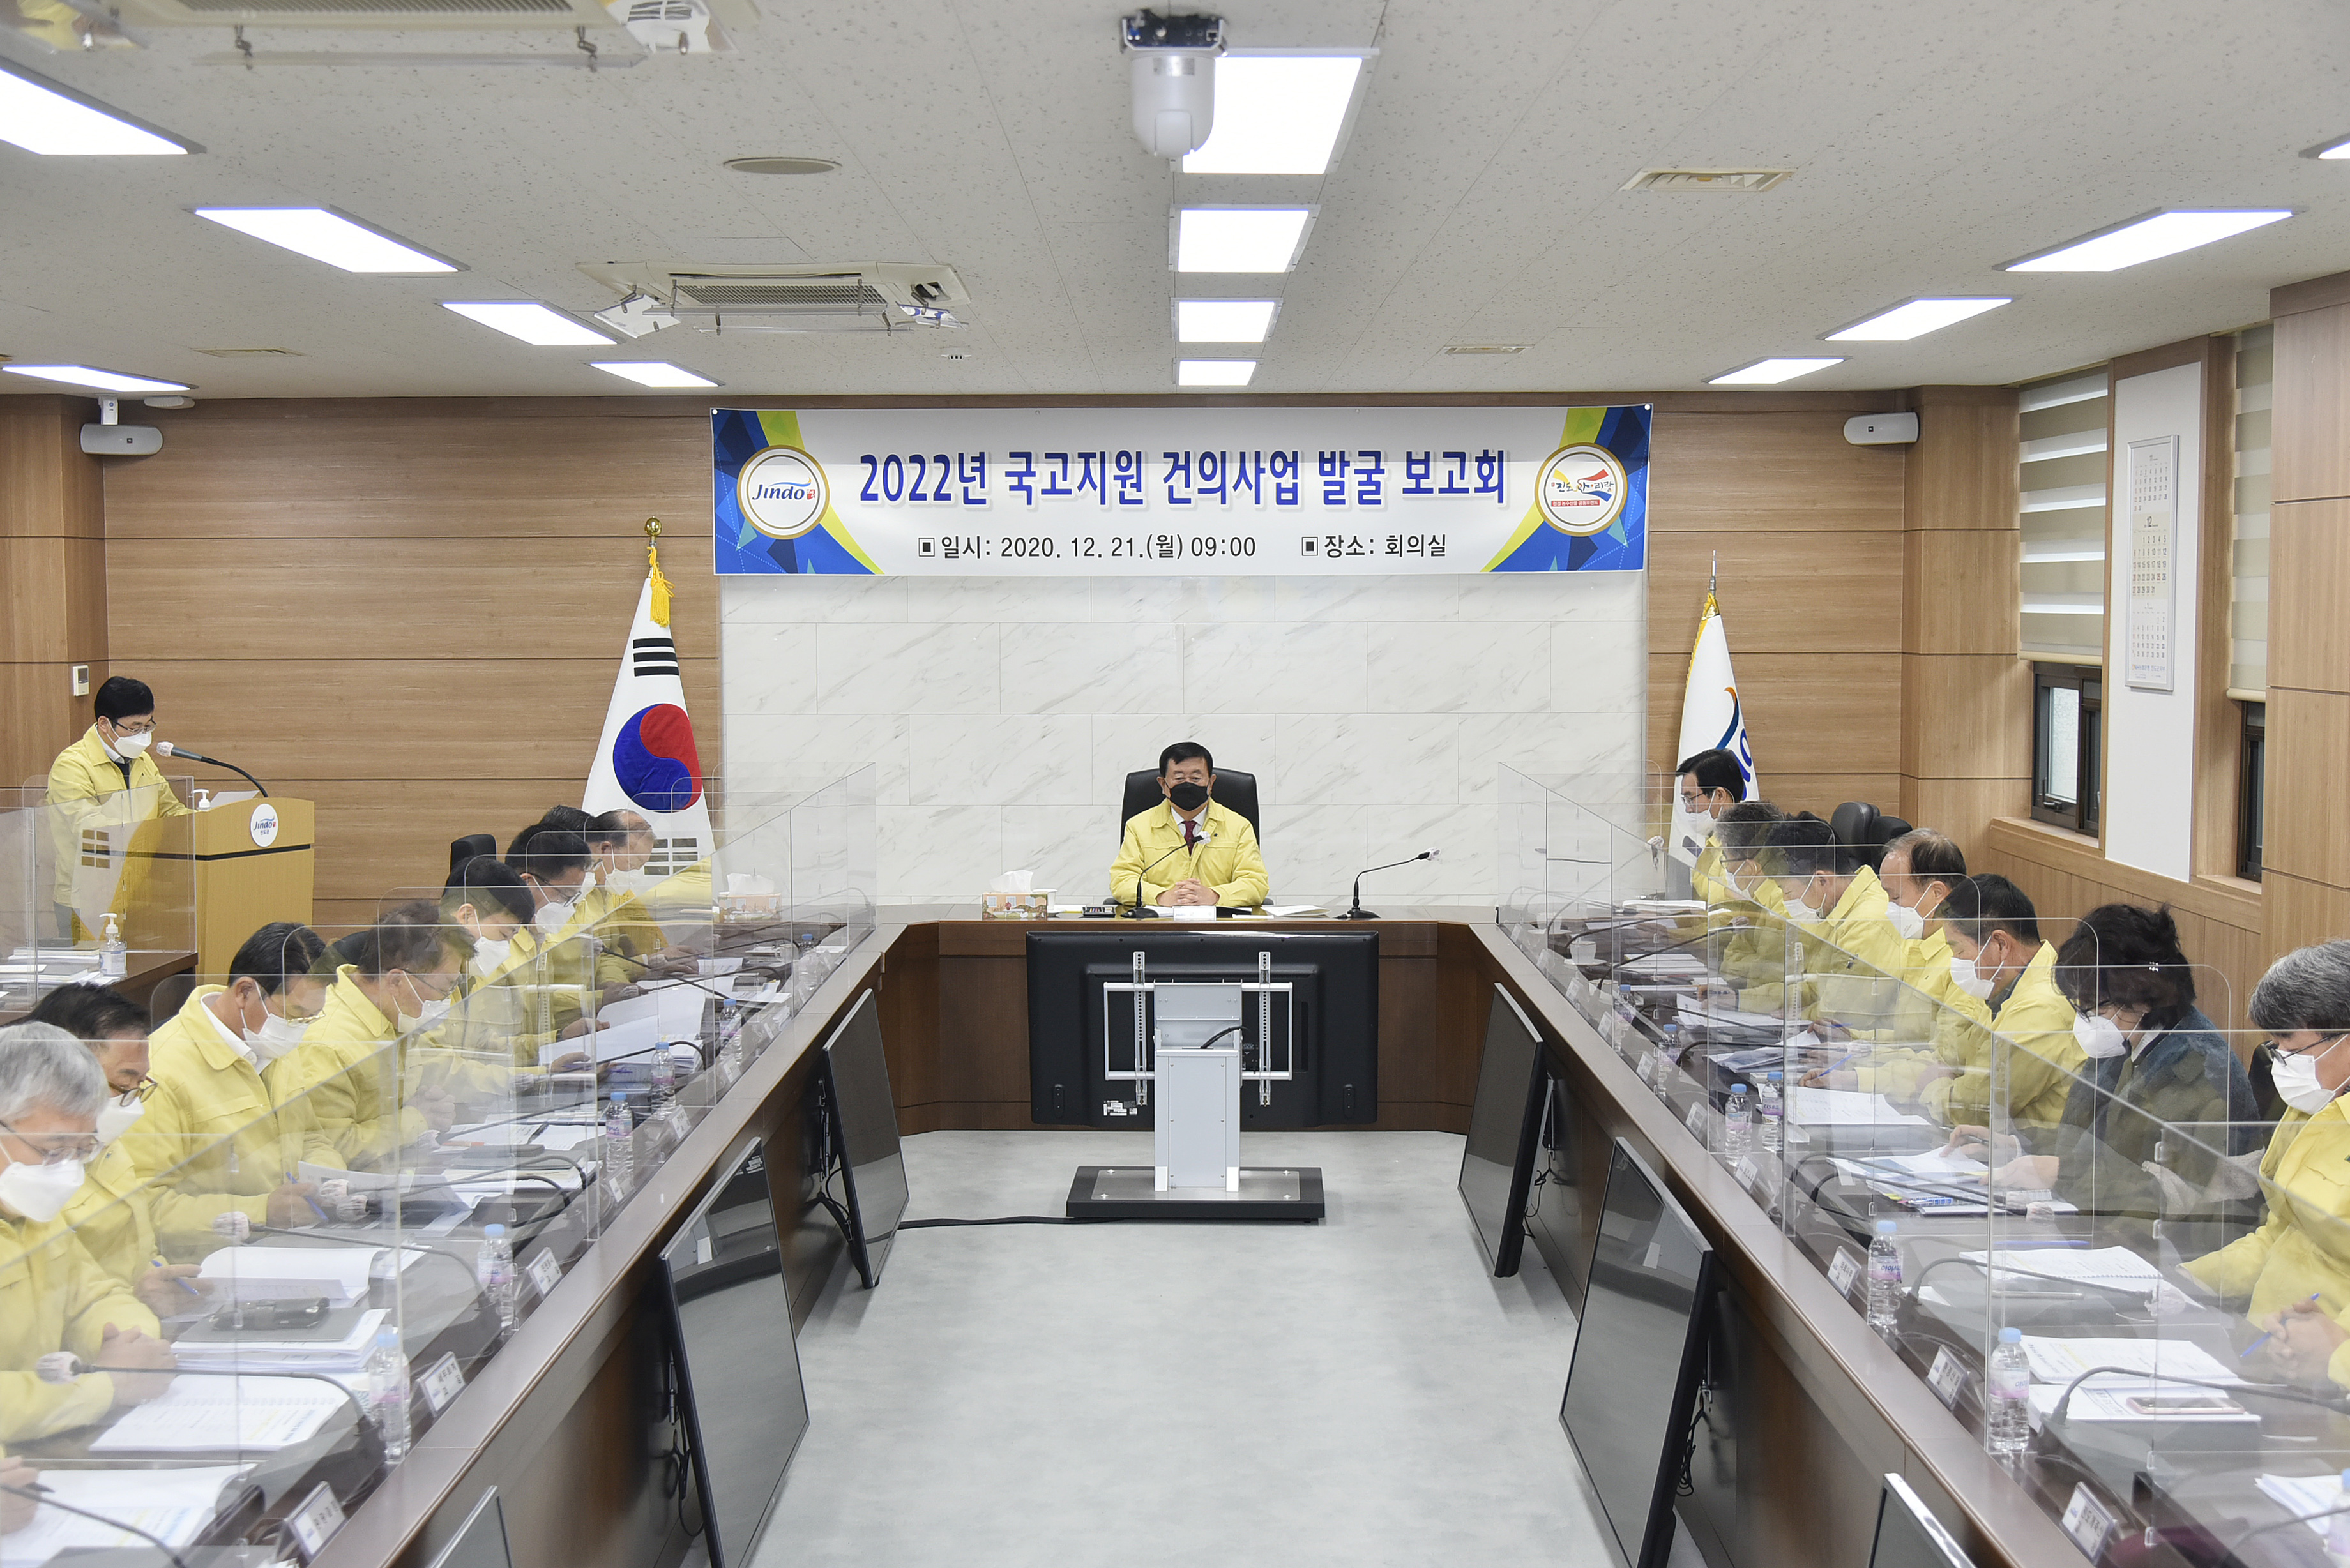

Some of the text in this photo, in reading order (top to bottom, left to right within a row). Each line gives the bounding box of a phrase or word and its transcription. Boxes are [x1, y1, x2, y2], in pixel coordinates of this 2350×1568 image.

[860, 449, 1505, 506] 2022년 국고지원 건의사업 발굴 보고회
[752, 484, 805, 500] Jindo
[941, 536, 991, 559] 일시:
[1001, 537, 1061, 558] 2020.
[1071, 537, 1103, 558] 12.
[1191, 536, 1256, 557] 09:00
[1324, 534, 1446, 558] 장소: 회의실
[254, 821, 273, 831] Jindo
